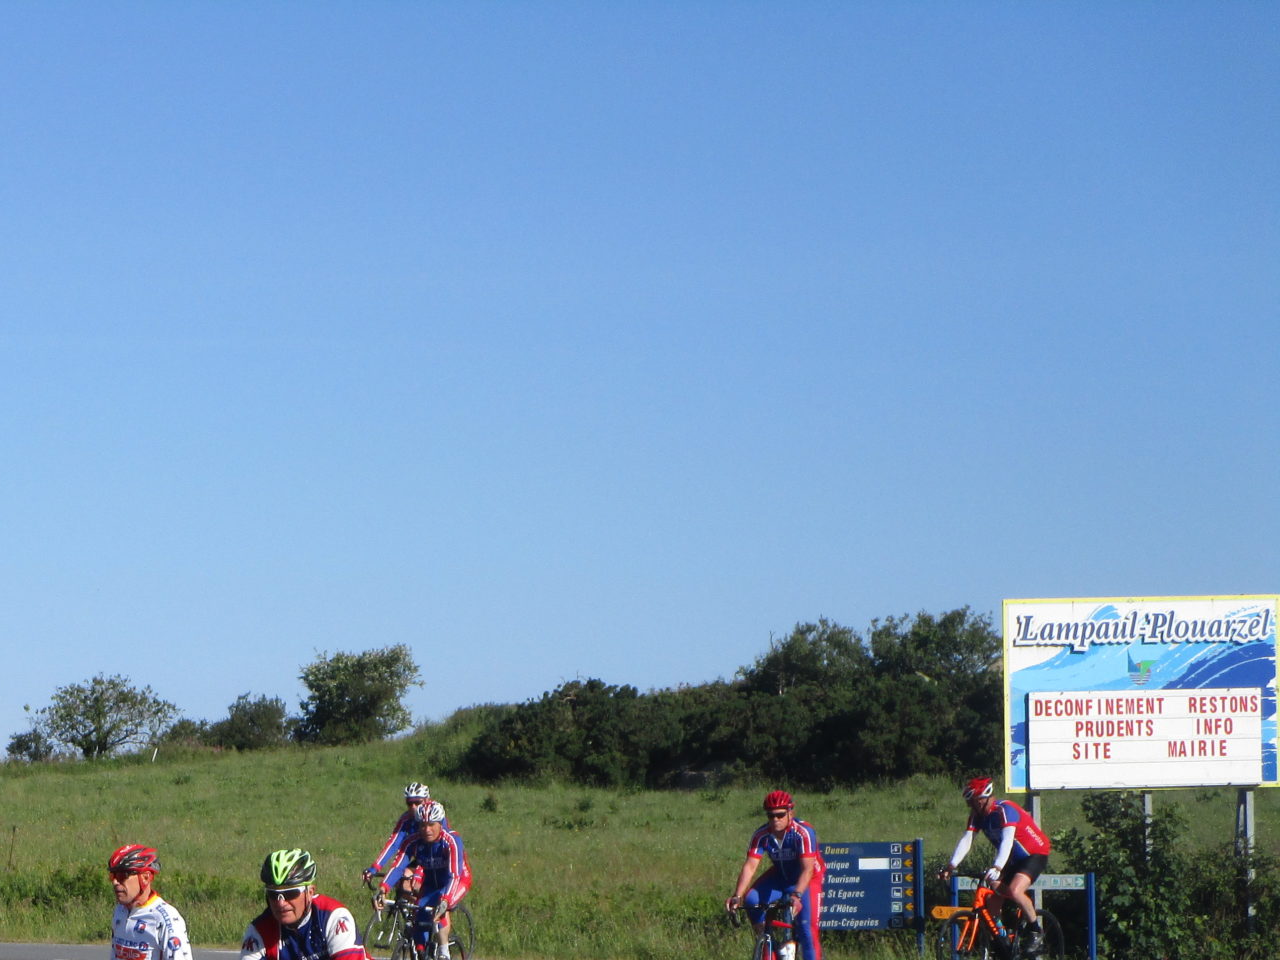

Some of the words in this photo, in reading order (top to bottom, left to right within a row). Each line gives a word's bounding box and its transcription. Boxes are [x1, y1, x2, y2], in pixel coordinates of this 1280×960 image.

[1019, 608, 1270, 648] Lampaul-Plouarzel
[1034, 697, 1165, 717] DECONFINEMENT
[1188, 695, 1259, 714] RESTONS
[1075, 719, 1154, 738] PRUDENTS
[1196, 717, 1234, 735] INFO
[1072, 742, 1111, 760] SITE
[1168, 739, 1228, 758] MAIRIE
[827, 874, 860, 883] Tourisme
[827, 889, 836, 898] St
[837, 889, 865, 899] Egarec
[818, 917, 880, 928] rants-Crêperies
